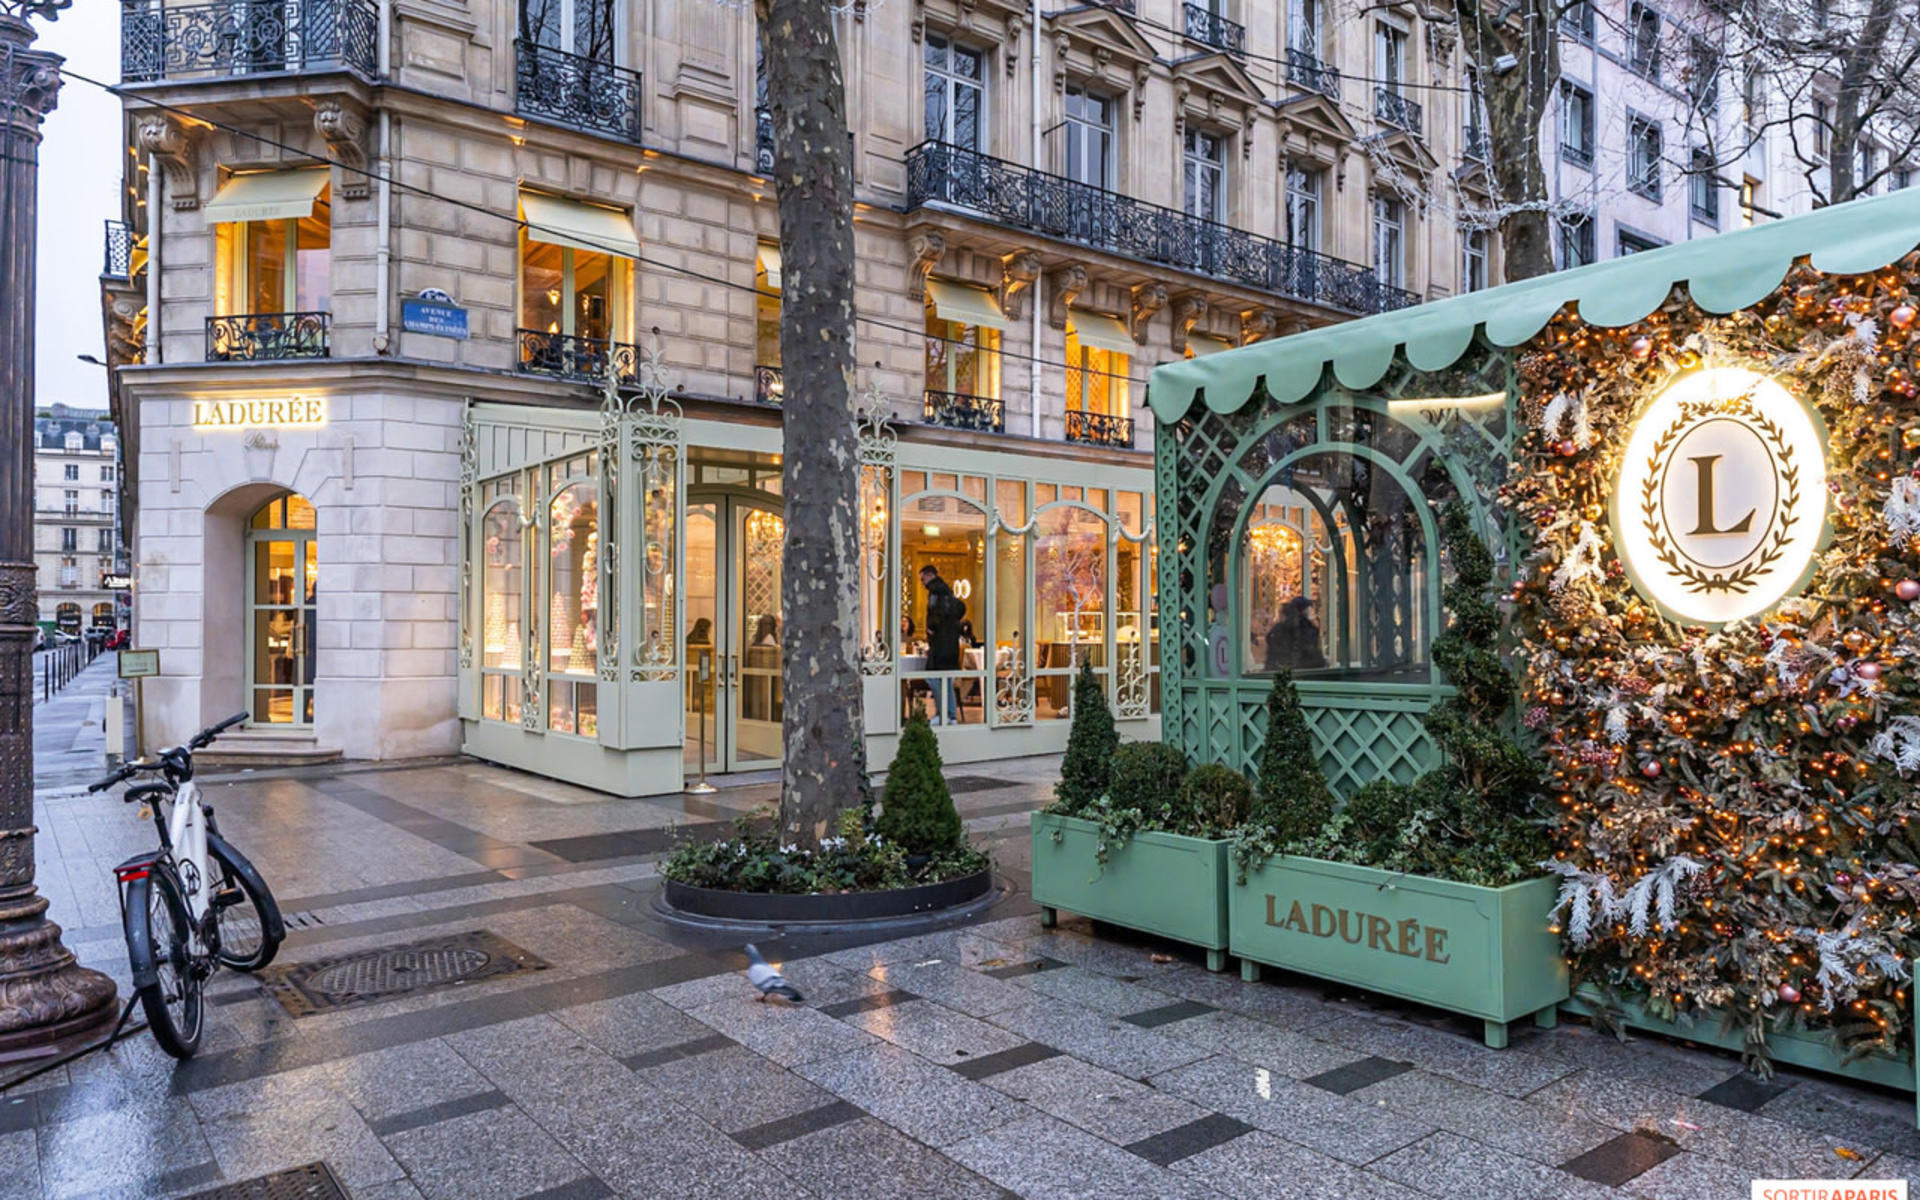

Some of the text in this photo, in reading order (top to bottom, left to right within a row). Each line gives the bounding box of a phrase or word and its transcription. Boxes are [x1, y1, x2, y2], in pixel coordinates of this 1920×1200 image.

[421, 307, 452, 318] AVENUE
[193, 396, 322, 425] LADURÉE
[1685, 454, 1757, 536] L
[1264, 893, 1451, 965] LADURÉE
